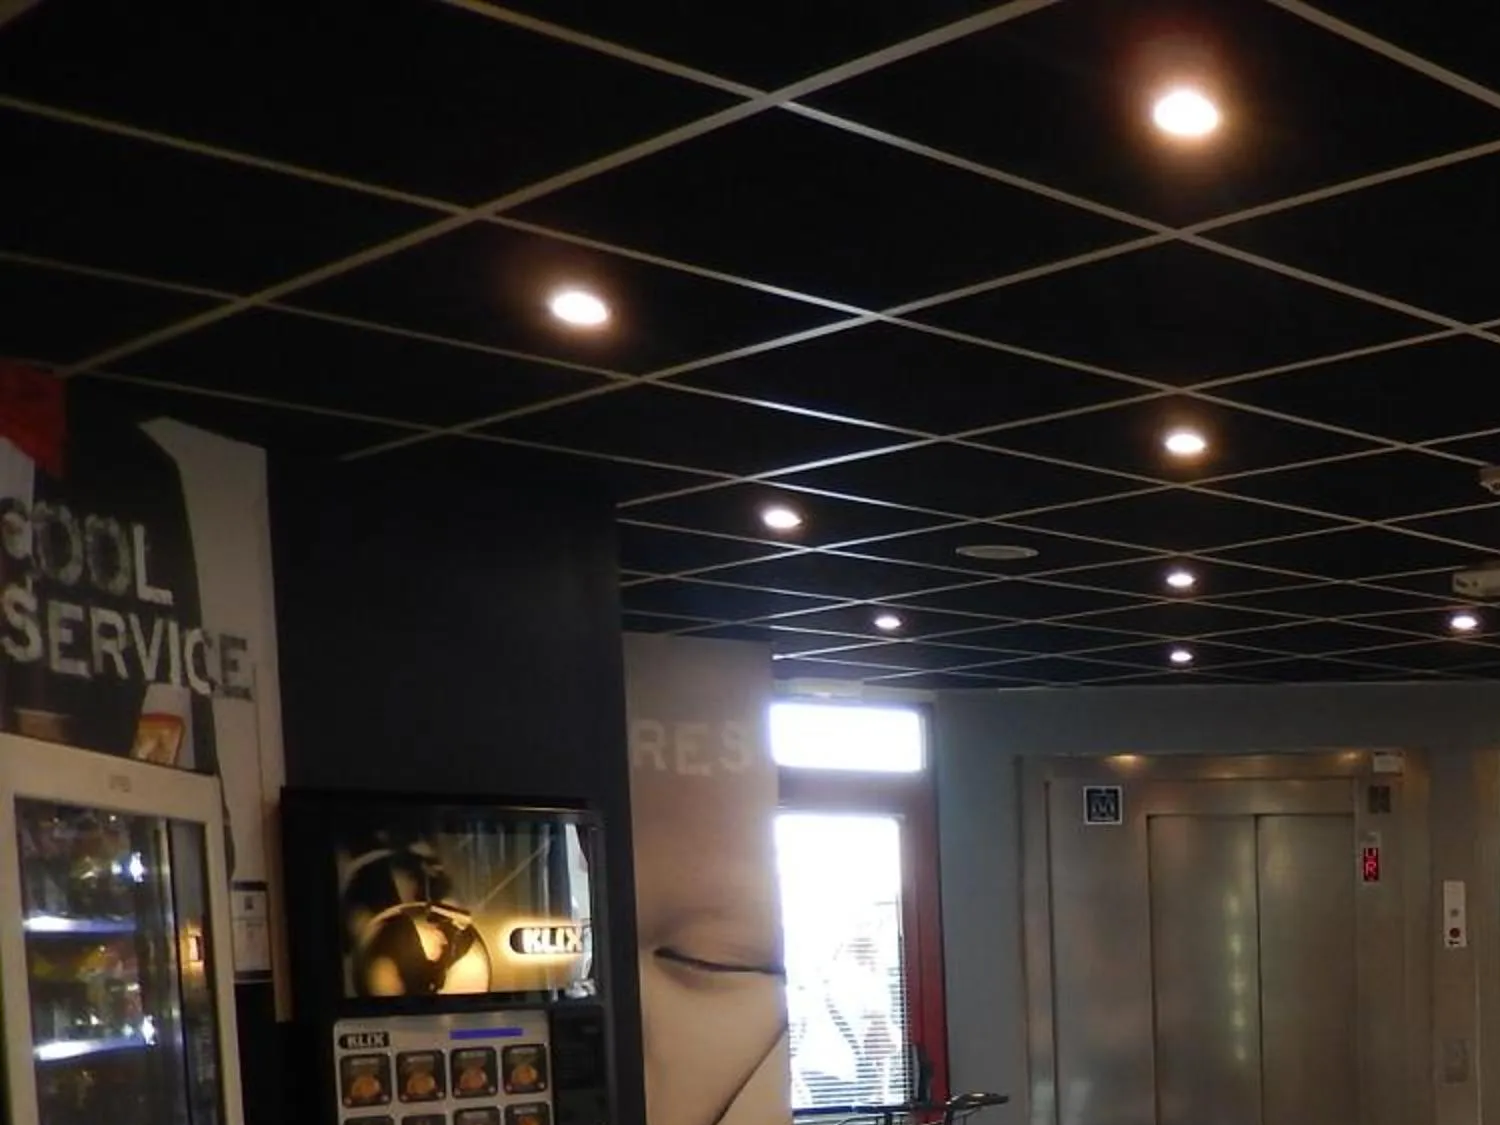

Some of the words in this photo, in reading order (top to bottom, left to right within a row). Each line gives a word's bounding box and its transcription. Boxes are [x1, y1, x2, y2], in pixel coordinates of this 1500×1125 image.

[0, 577, 254, 703] SERVICE
[632, 719, 752, 777] RES
[522, 927, 583, 954] KLIX
[346, 1031, 385, 1049] KLIX
